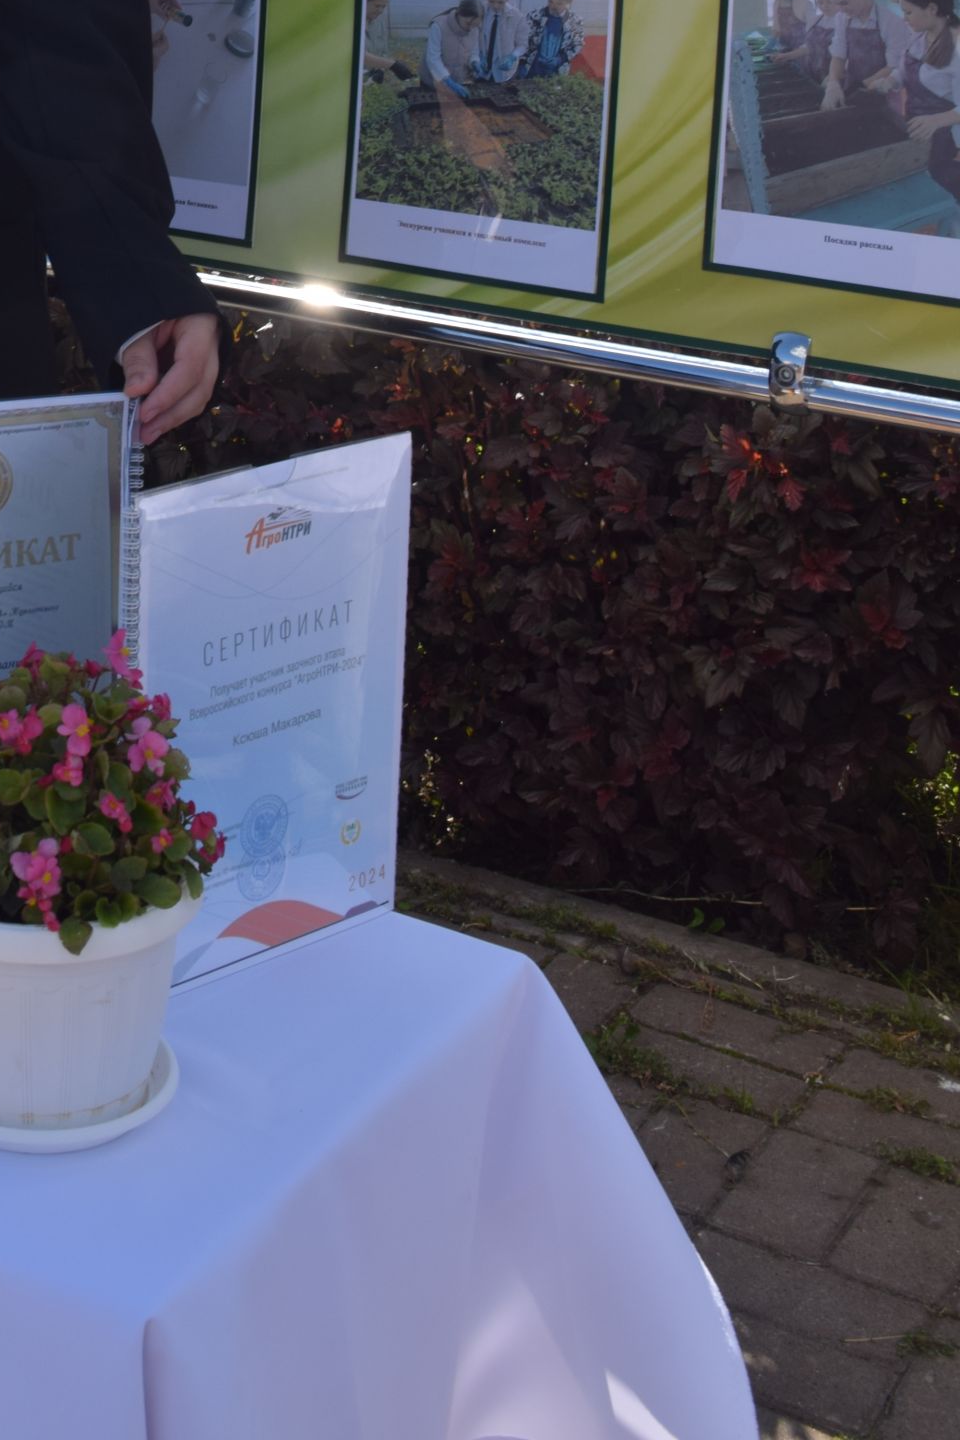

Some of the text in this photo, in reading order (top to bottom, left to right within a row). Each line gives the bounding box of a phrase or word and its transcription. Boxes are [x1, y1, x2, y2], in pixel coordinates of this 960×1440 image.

[203, 599, 353, 667] СЕРТИФИКАТ
[209, 677, 247, 698] Получает
[250, 666, 284, 688] участник
[189, 689, 255, 721] Всероссийского
[232, 709, 321, 747] Ксюша Макарова
[348, 864, 386, 892] 2024
